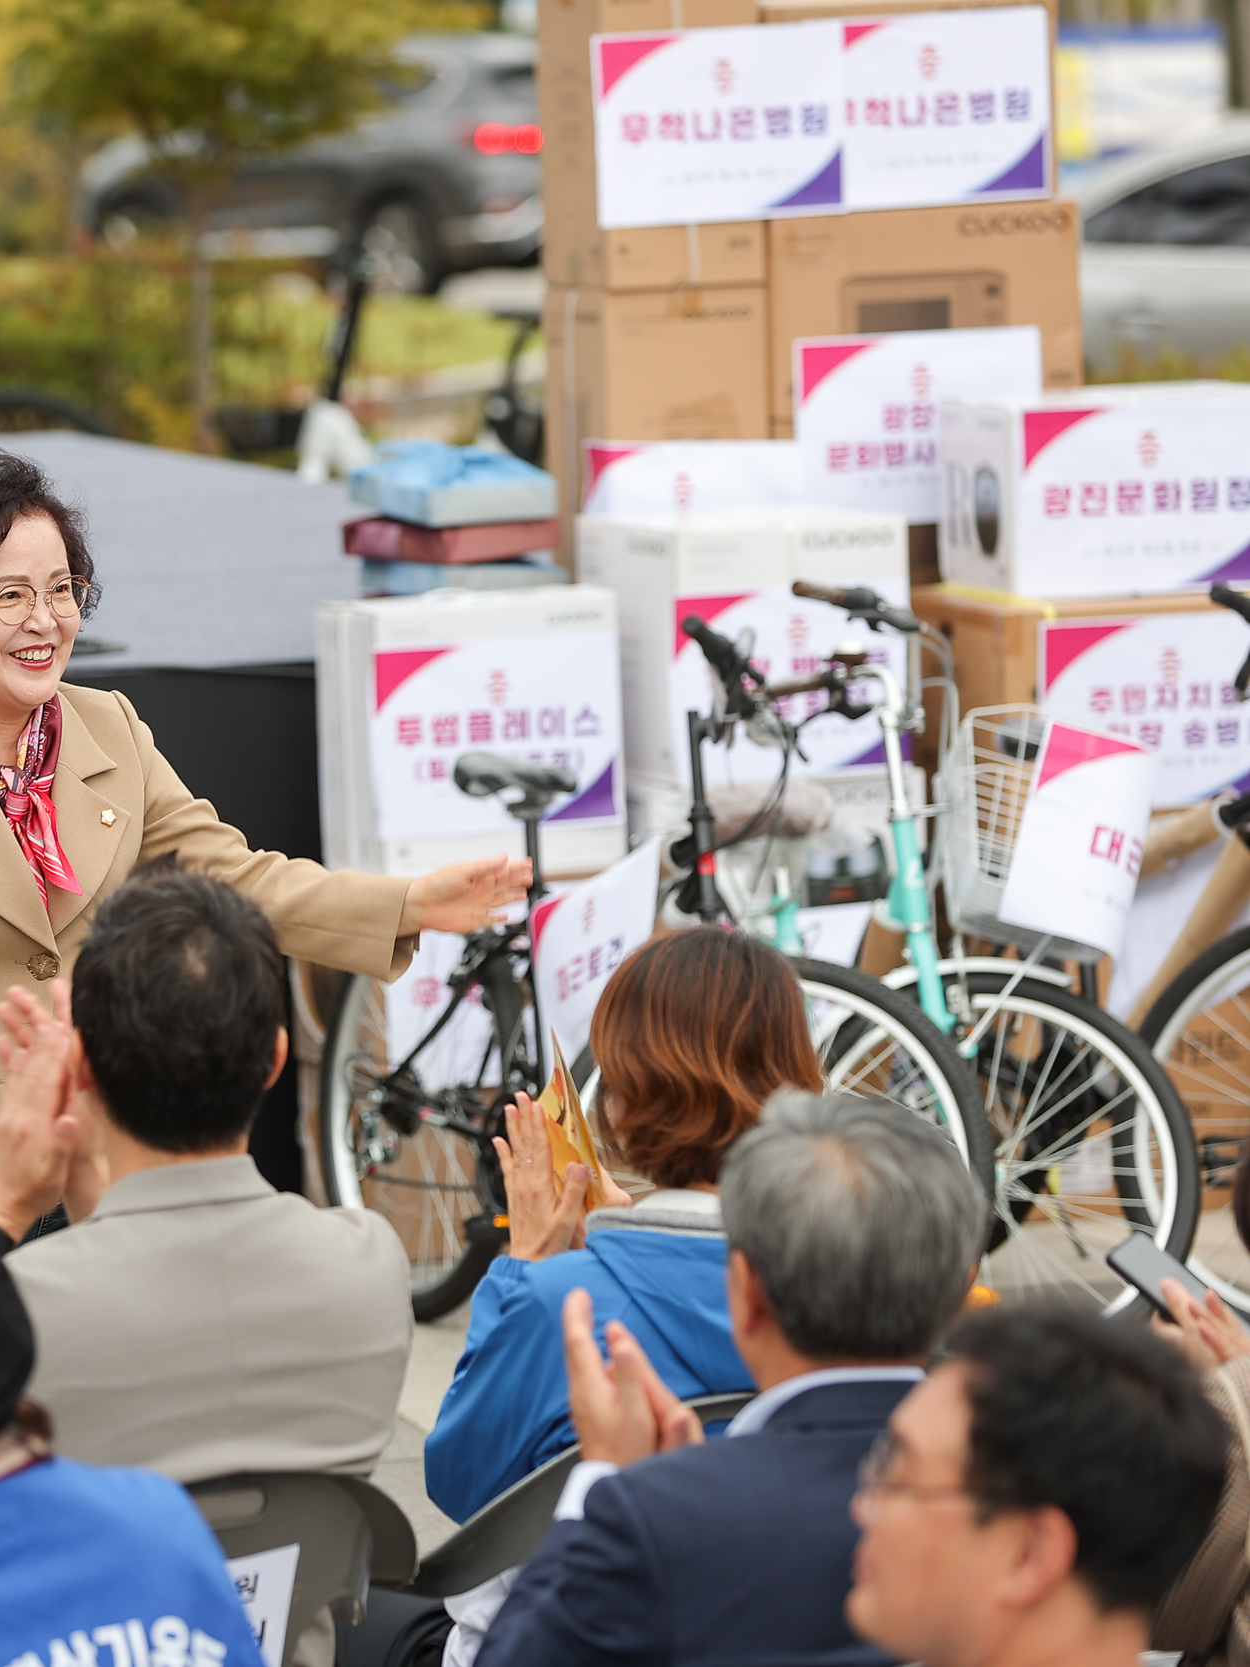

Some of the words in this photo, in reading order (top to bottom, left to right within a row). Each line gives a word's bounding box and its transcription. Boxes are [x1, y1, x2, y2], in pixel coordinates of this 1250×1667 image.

[621, 104, 828, 143] 무척나은병원
[958, 208, 1071, 237] CUCKOO
[396, 706, 601, 747] 투썸플레이스
